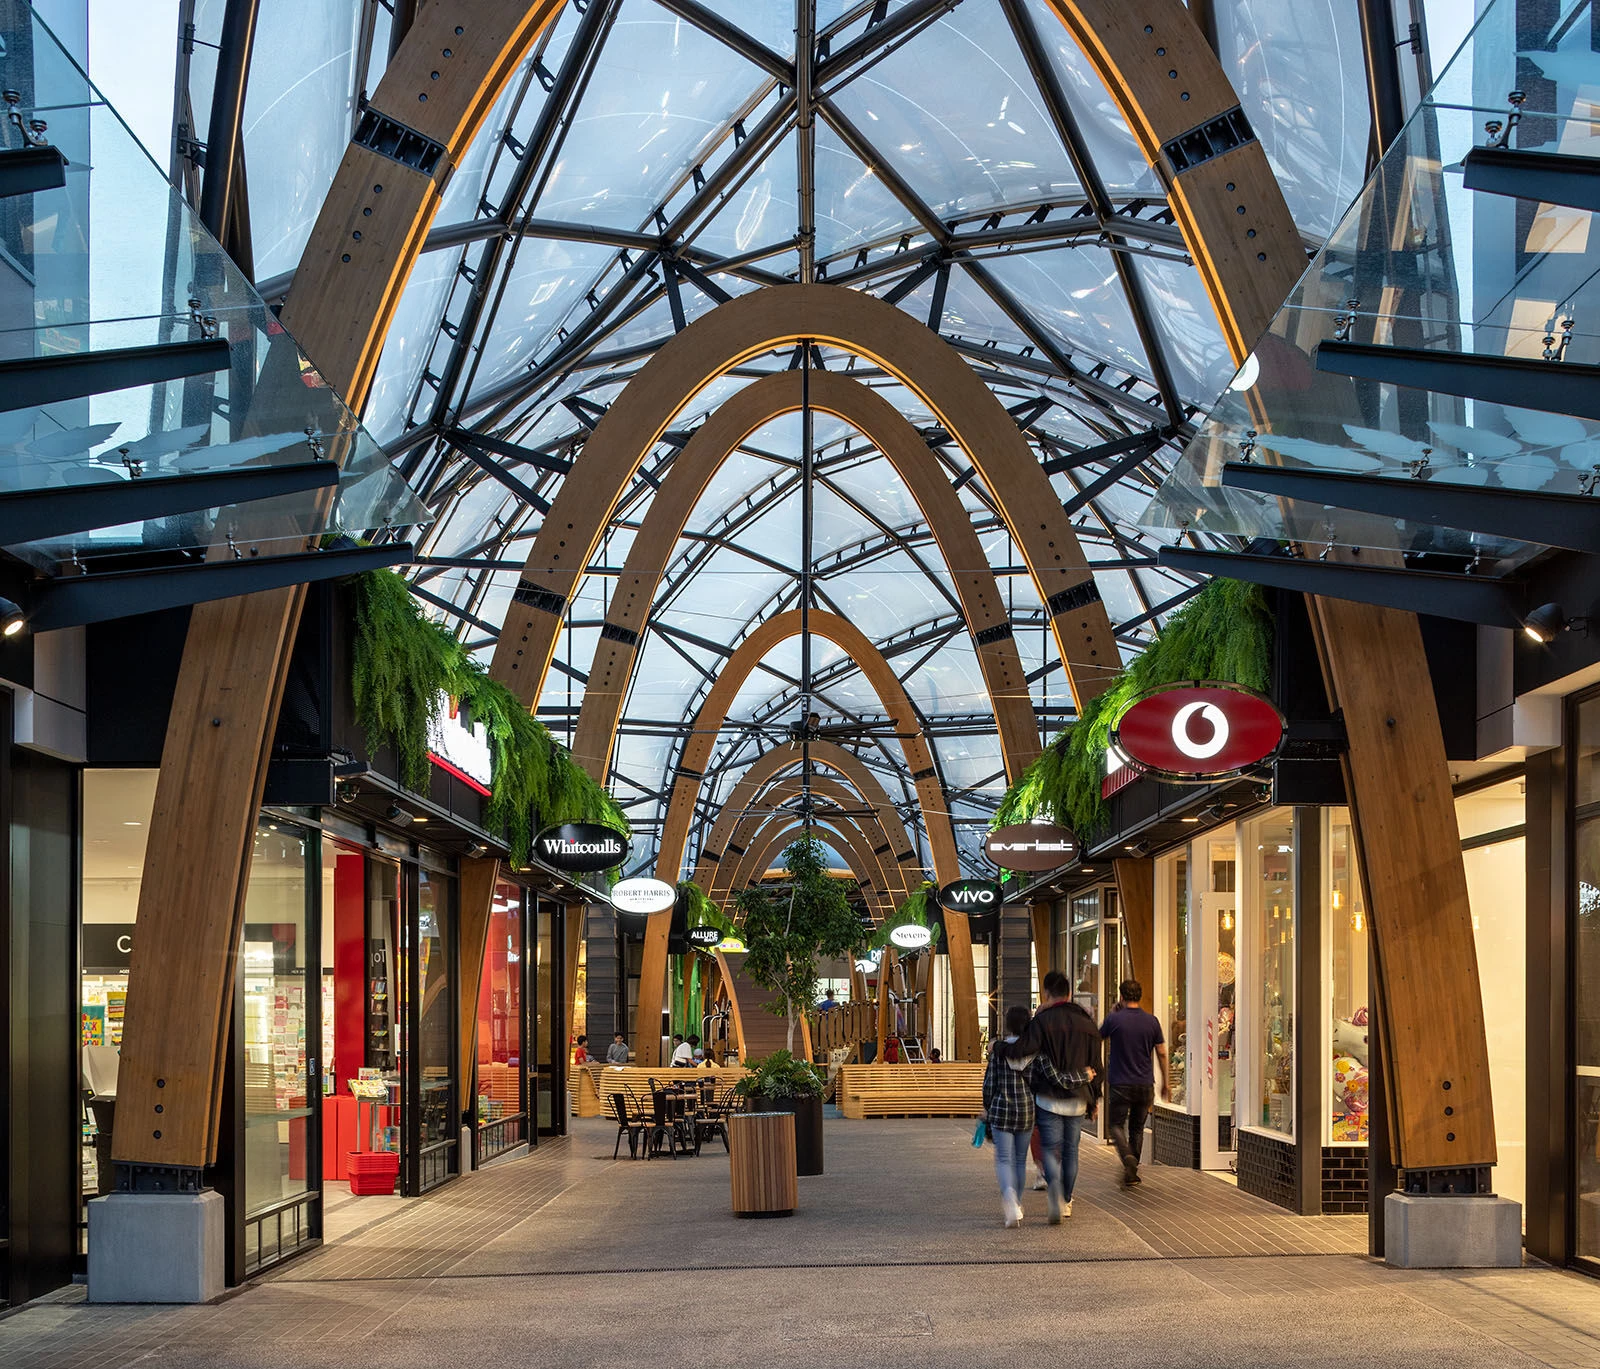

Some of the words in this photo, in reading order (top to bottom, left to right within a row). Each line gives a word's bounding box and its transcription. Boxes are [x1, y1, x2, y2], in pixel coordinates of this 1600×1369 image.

[544, 838, 621, 854] Whitcoulls
[612, 889, 642, 897] ROBERT
[643, 889, 671, 897] HARRIS
[691, 931, 718, 939] ALLURE
